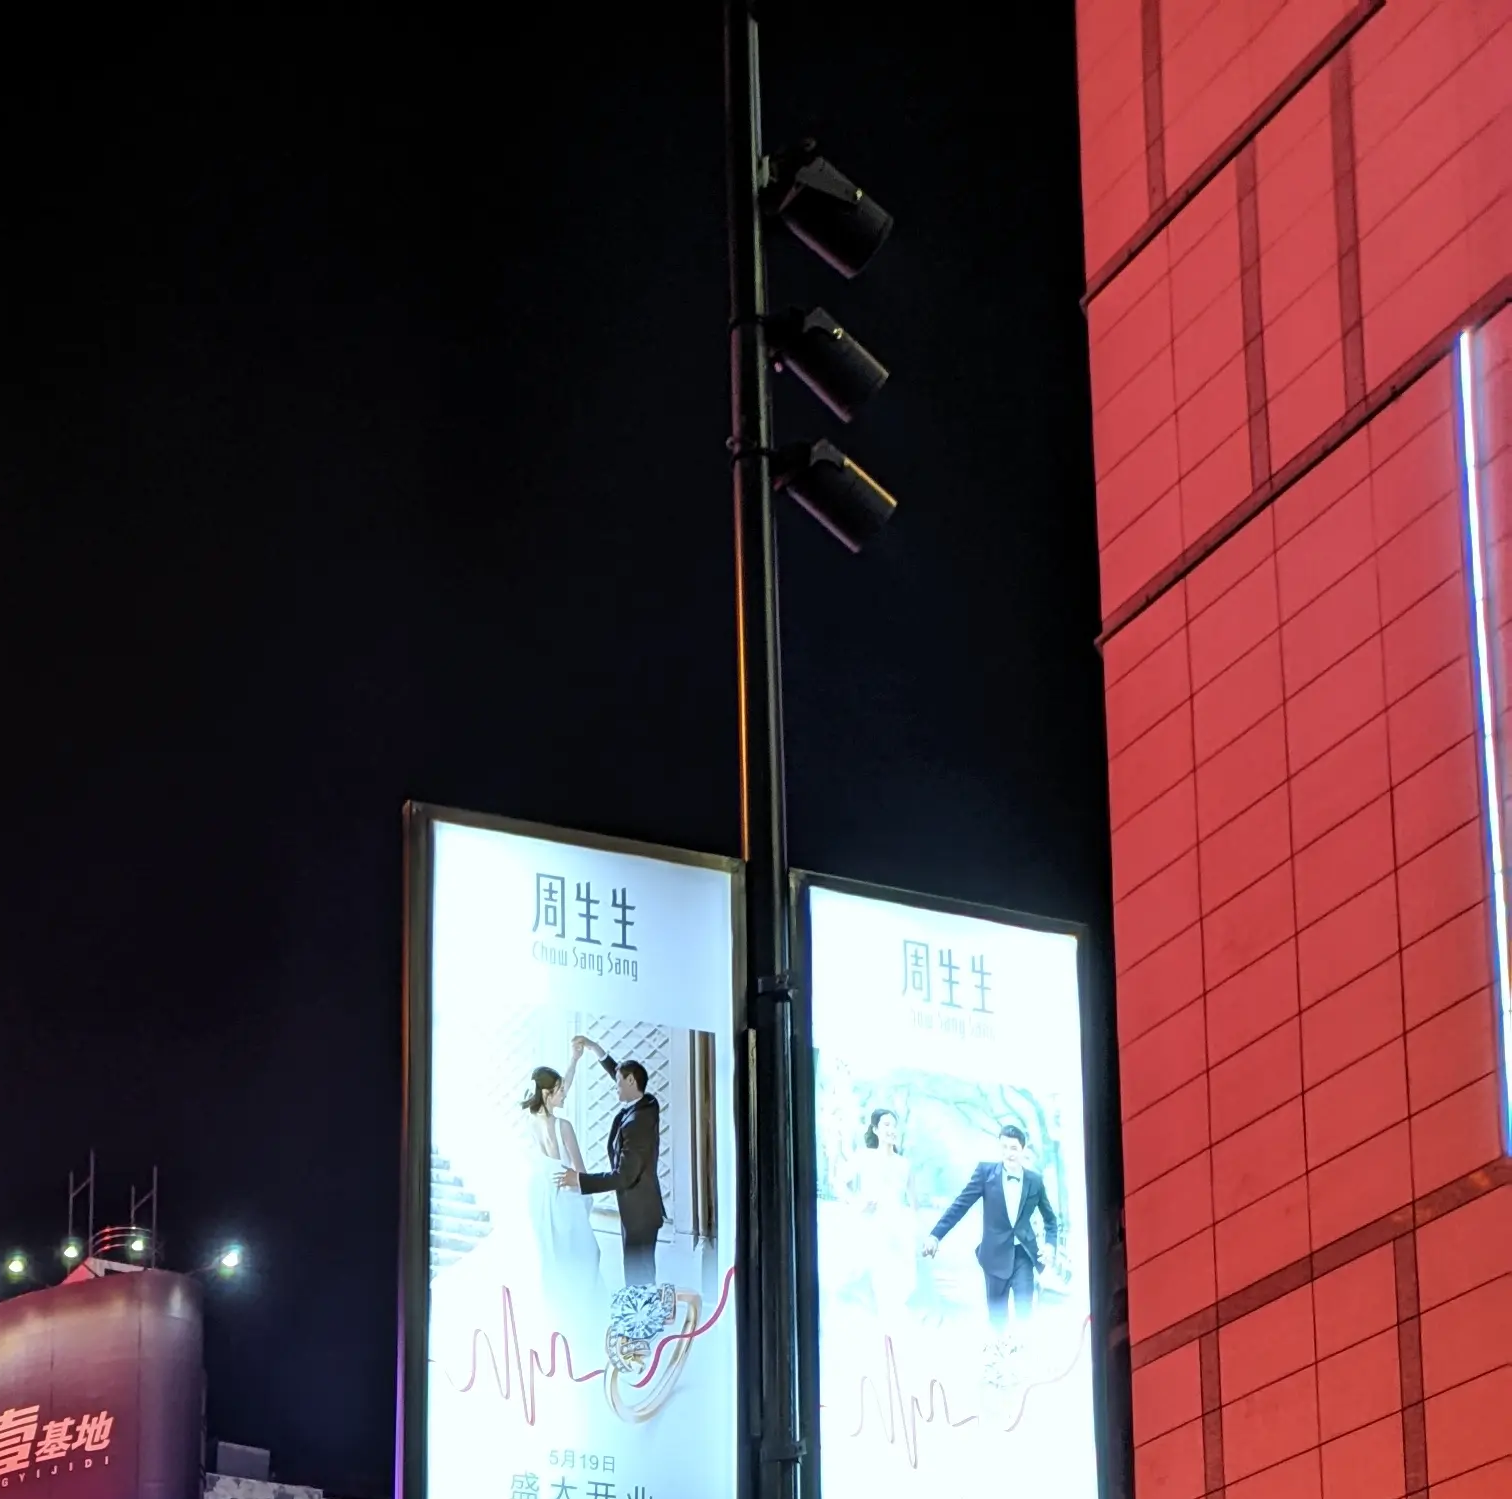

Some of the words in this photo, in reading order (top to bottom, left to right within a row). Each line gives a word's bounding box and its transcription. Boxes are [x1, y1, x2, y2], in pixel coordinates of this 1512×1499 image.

[532, 872, 638, 951] 周生生
[532, 941, 568, 967] Chow
[572, 947, 604, 977] Sang
[607, 952, 638, 982] Sang
[901, 939, 995, 1014] 周生生
[548, 1449, 616, 1474] 5月19日
